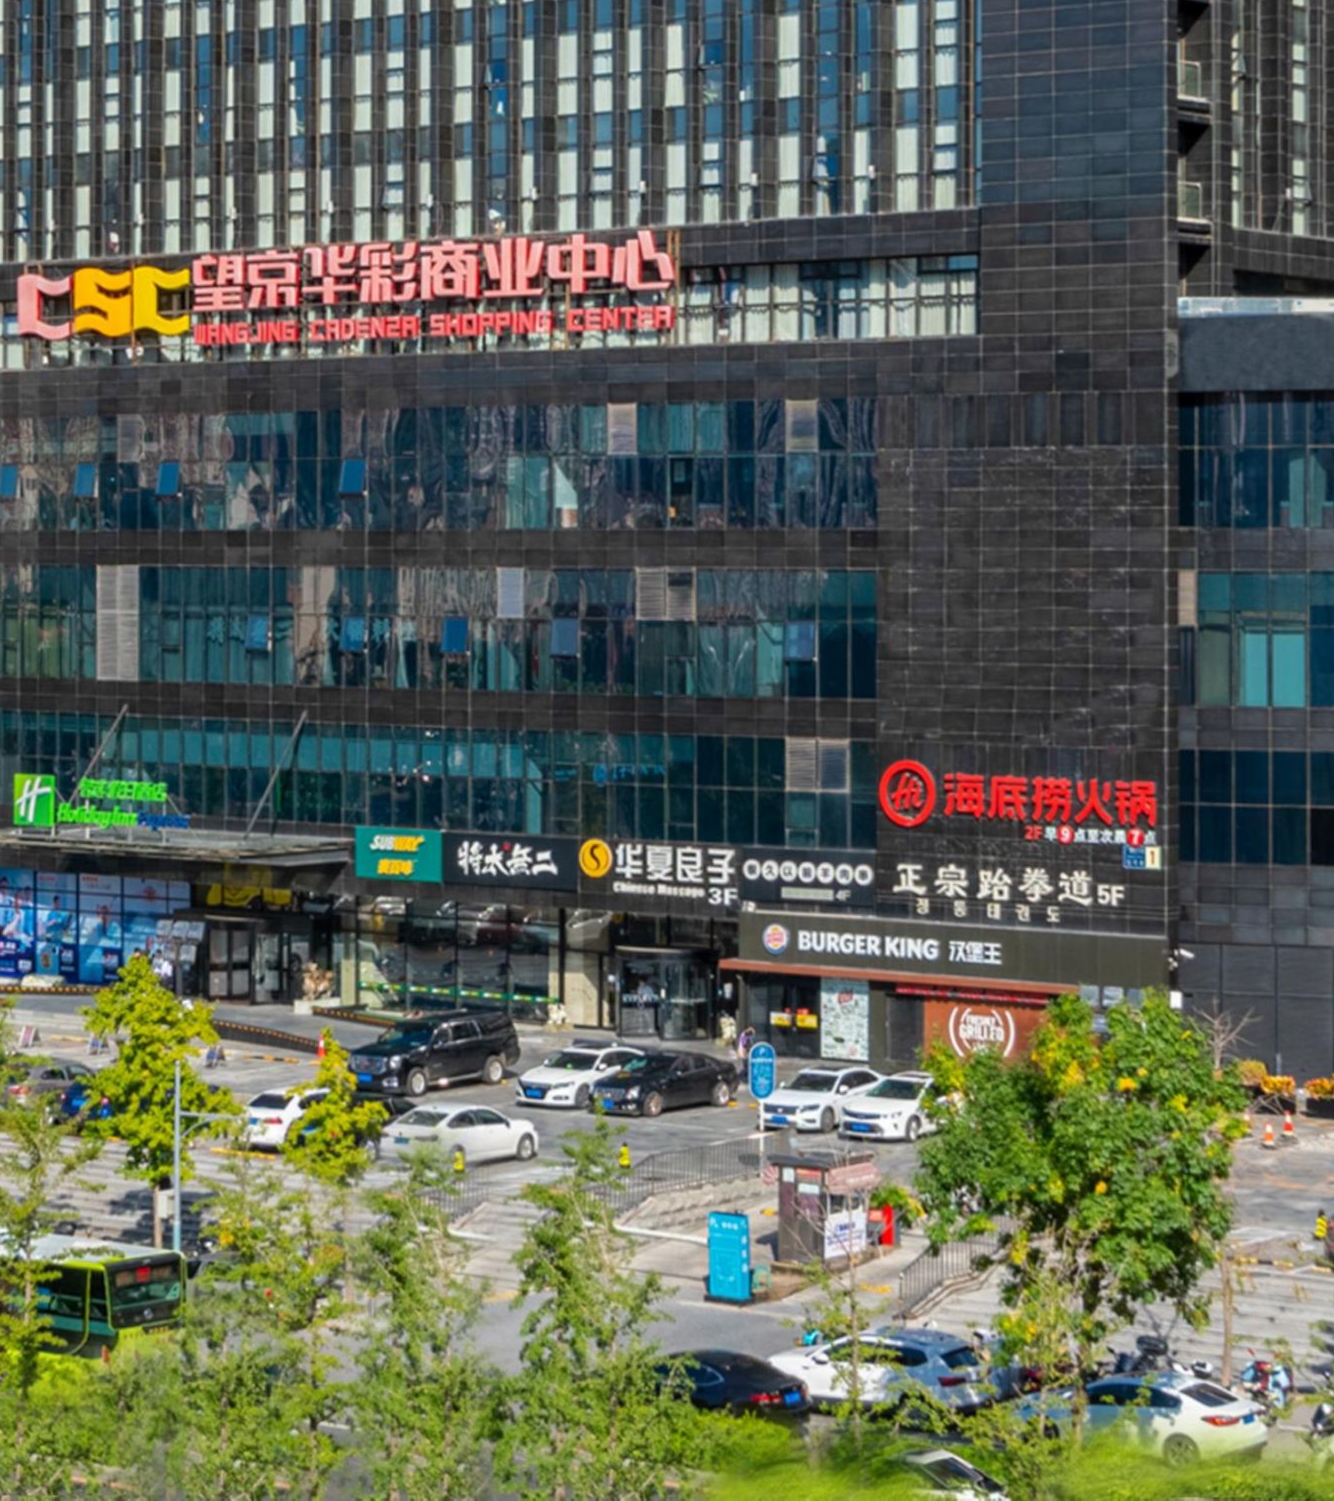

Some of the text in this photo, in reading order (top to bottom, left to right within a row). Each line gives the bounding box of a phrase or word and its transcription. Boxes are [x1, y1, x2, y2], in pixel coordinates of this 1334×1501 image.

[192, 230, 675, 312] 望京华彩商业中心
[17, 265, 190, 340] CSC
[193, 305, 675, 345] WANGJING CADENZA SHOPPING CENTER
[58, 803, 111, 829] Holiday
[112, 805, 138, 826] Inn
[942, 772, 1157, 827] 海底捞火锅
[369, 834, 424, 852] SUBWAY
[1023, 825, 1043, 840] 2F
[615, 843, 735, 884] 华夏良子
[708, 888, 738, 906] 3F
[892, 863, 1125, 906] 正宗跆拳道 5F
[798, 930, 880, 956] BURGER
[884, 936, 940, 960] KING
[948, 940, 1003, 965] 汉堡王
